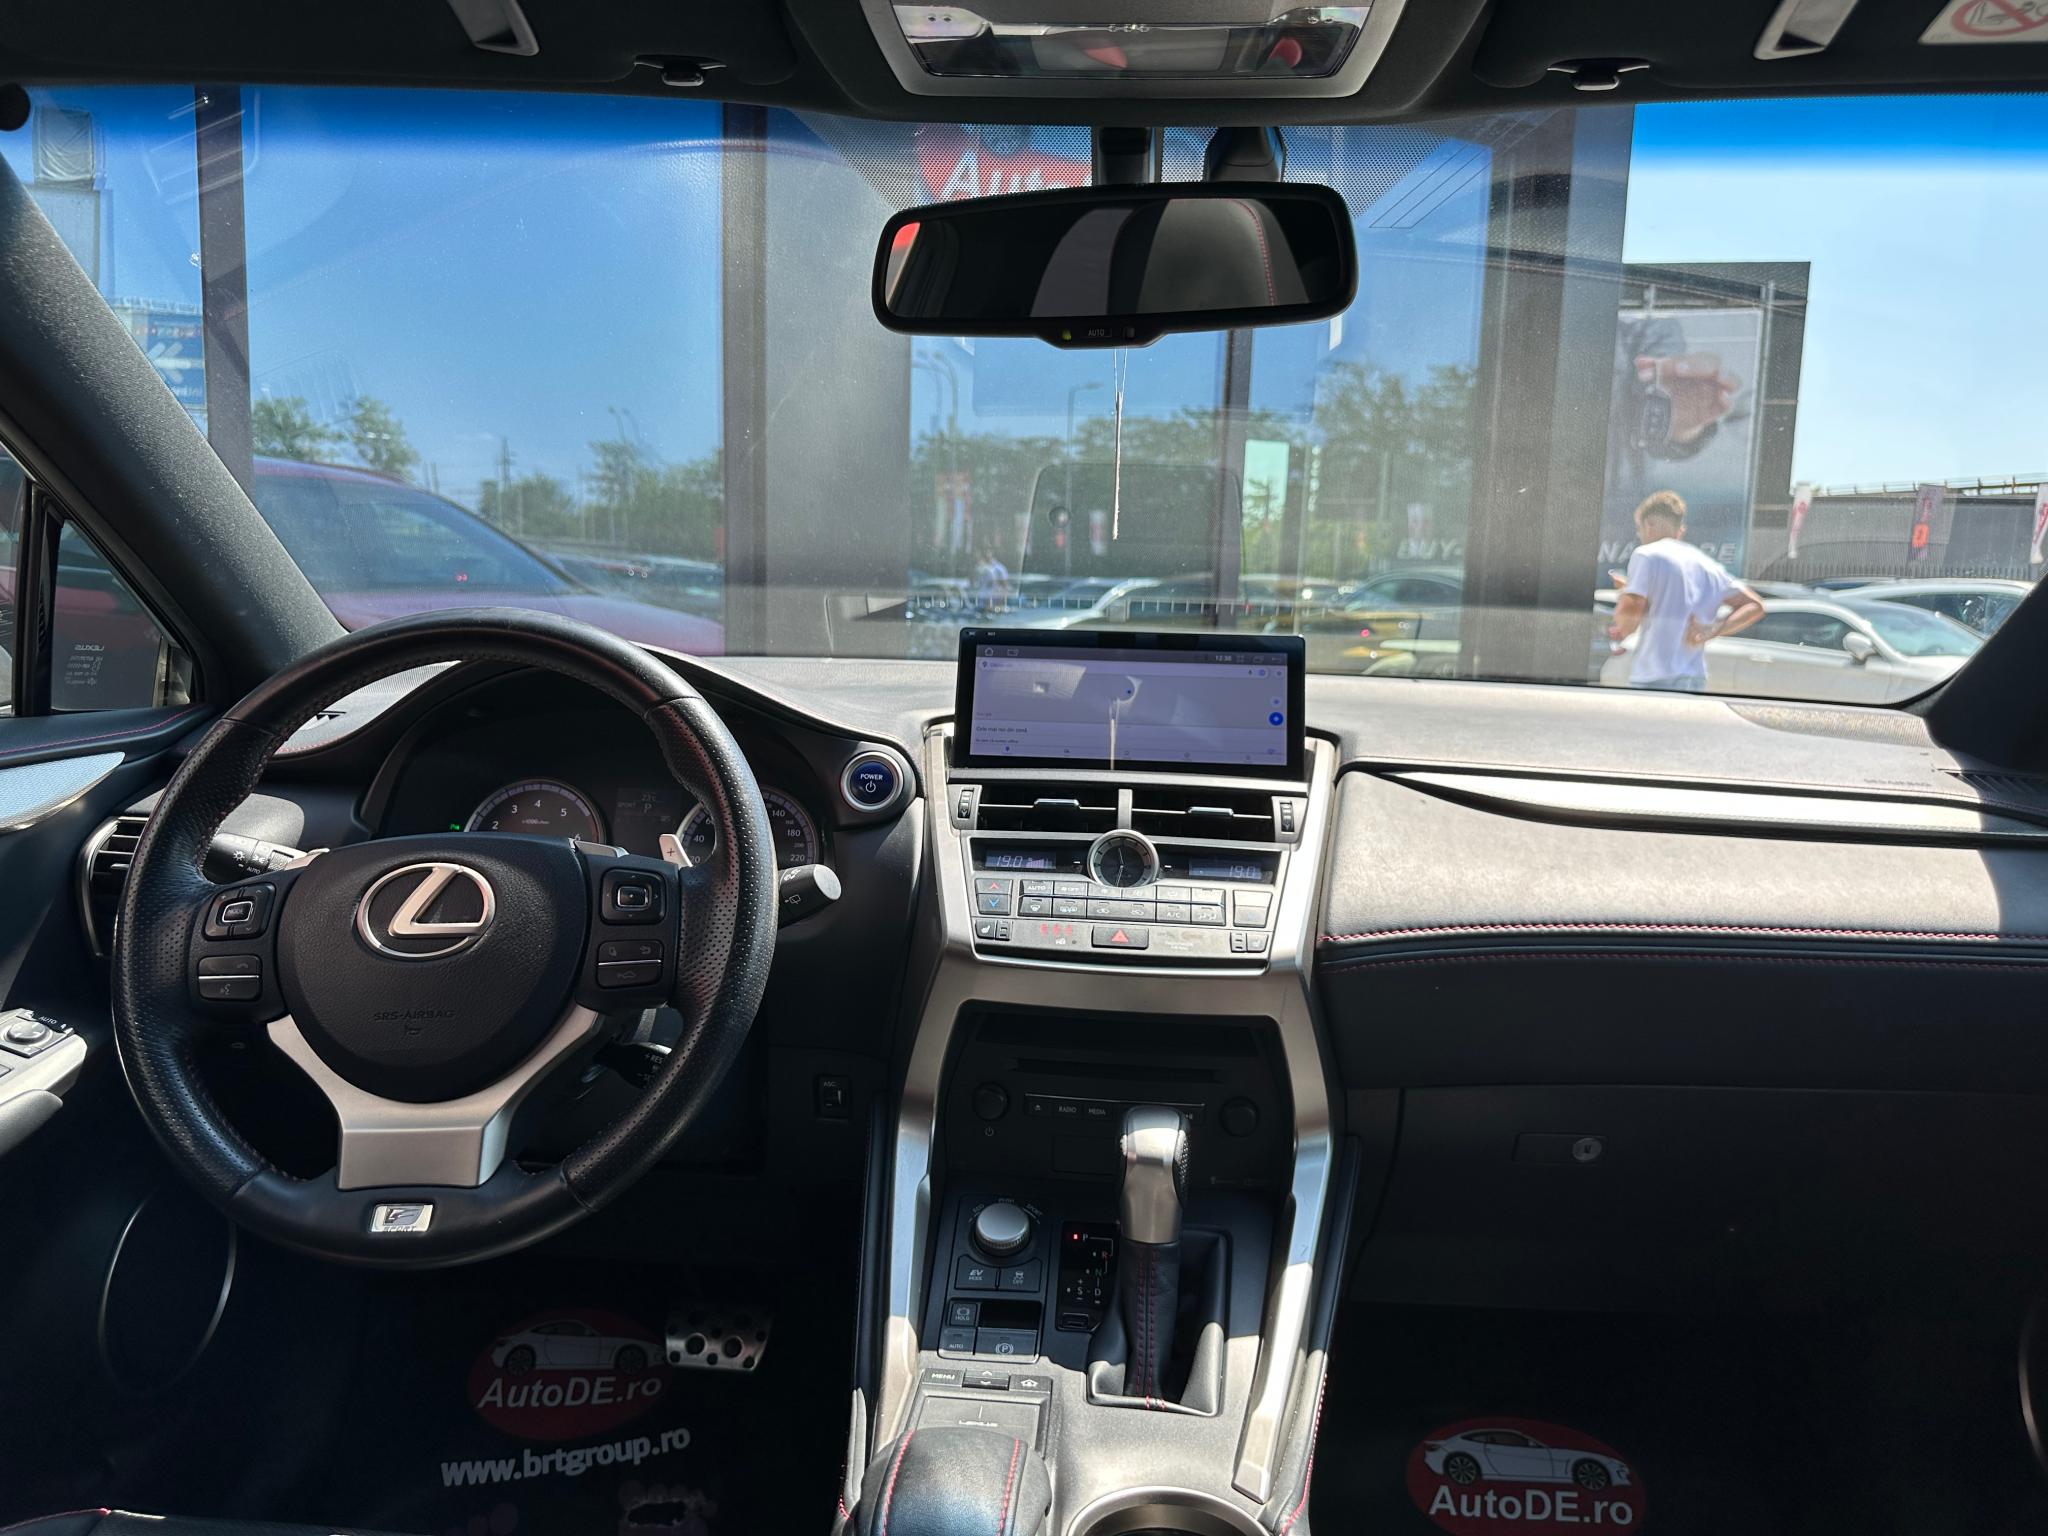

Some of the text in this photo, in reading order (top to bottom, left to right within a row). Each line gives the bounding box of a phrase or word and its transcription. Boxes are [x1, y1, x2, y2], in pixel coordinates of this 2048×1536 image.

[1088, 328, 1105, 336] AUTO
[533, 799, 542, 808] 4
[511, 804, 518, 814] 3
[560, 808, 568, 817] 5
[772, 809, 786, 817] 140
[491, 820, 499, 829] 2
[787, 829, 801, 837] 180
[693, 835, 705, 843] 40
[790, 854, 806, 862] 220
[997, 855, 1023, 868] 19.0
[247, 866, 261, 875] AUTO
[39, 1015, 58, 1025] AUTO
[1057, 1105, 1078, 1113] RADIO
[1082, 1233, 1089, 1242] P
[1102, 1250, 1110, 1259] R
[1095, 1268, 1102, 1277] N
[1077, 1286, 1083, 1295] S
[1094, 1288, 1102, 1296] D
[476, 1376, 663, 1409] AutoDE.ro
[440, 1427, 692, 1488] www.brtgroup.ro
[1429, 1484, 1633, 1526] AutoDE.ro
